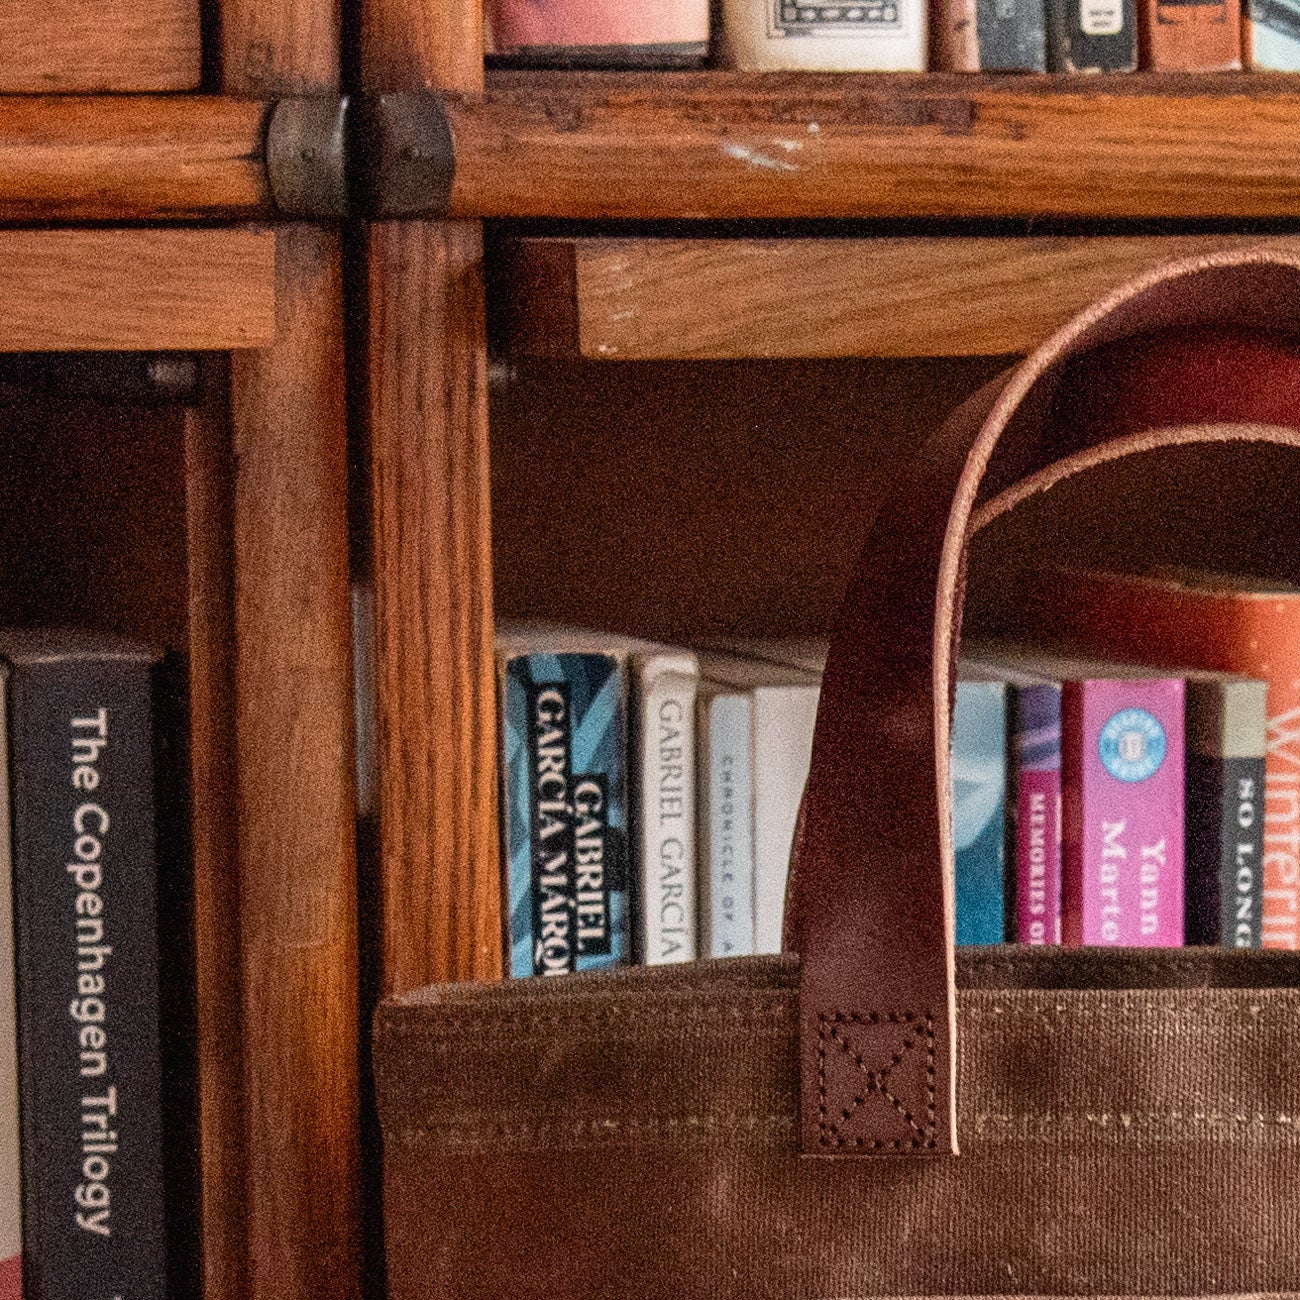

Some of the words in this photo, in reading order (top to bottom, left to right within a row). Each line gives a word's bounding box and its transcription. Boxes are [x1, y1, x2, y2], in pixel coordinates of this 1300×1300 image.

[70, 707, 108, 790] The
[535, 689, 574, 842] GARCÍA
[658, 699, 684, 827] GABRIEL
[574, 780, 605, 951] GABRIEL
[719, 754, 735, 885] CHRONICLE
[1028, 792, 1046, 915] MEMORIES
[1099, 817, 1128, 942] Marte
[66, 803, 113, 1077] Copenhagen
[720, 894, 735, 924] OF
[720, 939, 735, 954] A
[1139, 836, 1167, 937] Yann
[75, 1087, 118, 1237] Trilogy
